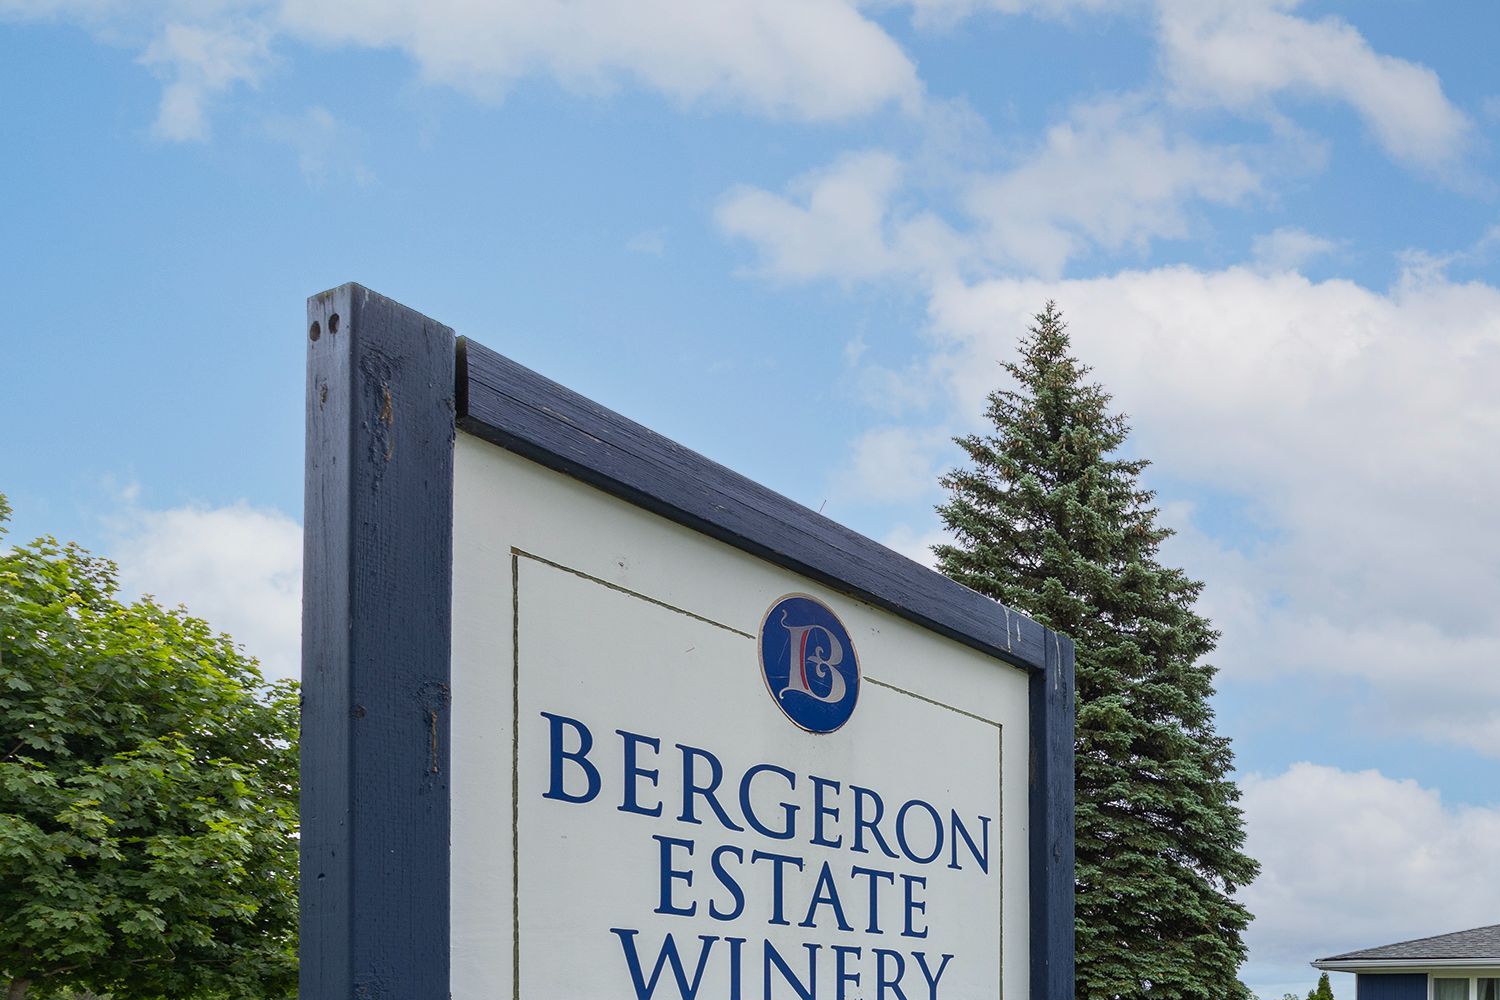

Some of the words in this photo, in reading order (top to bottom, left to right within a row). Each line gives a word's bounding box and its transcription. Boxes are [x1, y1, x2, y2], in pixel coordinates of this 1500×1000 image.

[779, 609, 846, 703] B
[541, 711, 991, 875] BERGERON
[652, 835, 929, 939] ESTATE
